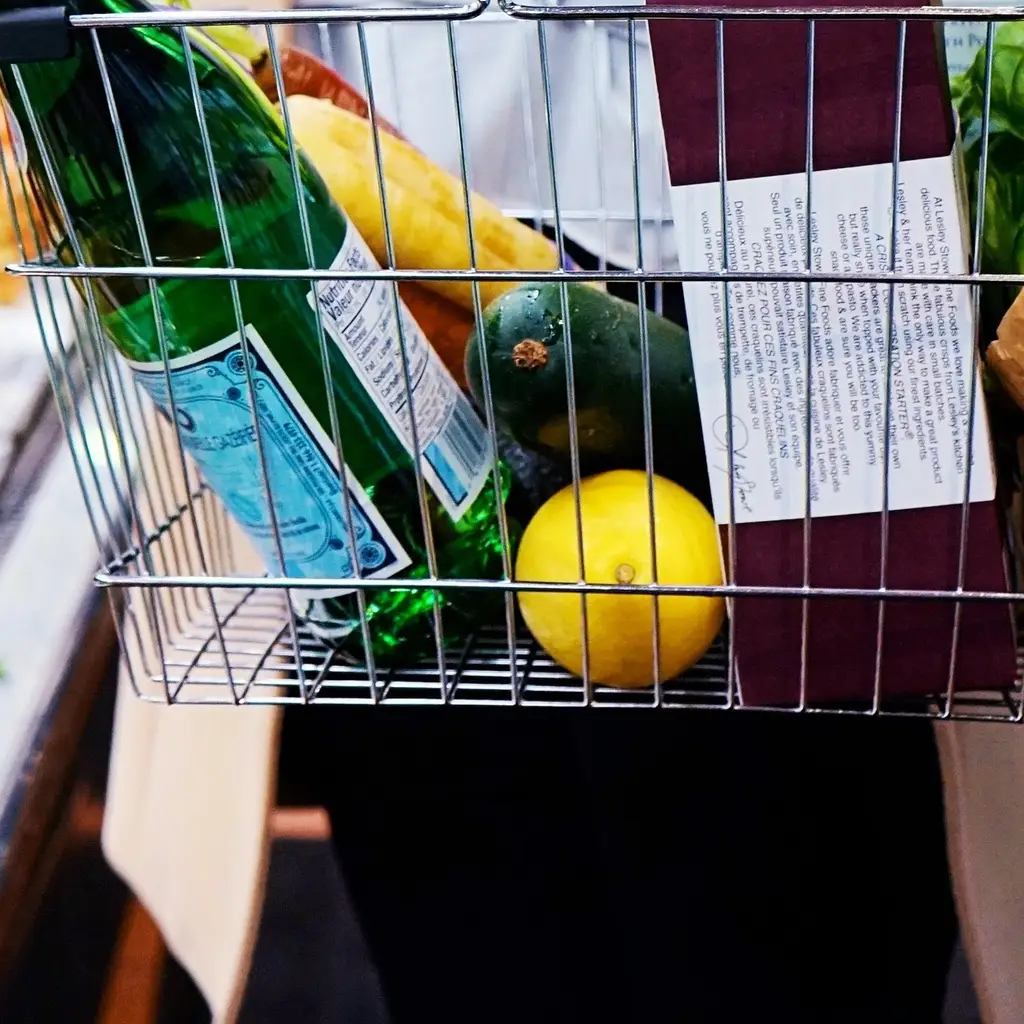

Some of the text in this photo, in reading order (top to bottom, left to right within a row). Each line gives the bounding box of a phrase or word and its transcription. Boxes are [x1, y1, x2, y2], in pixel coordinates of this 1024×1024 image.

[770, 191, 781, 214] Seul
[700, 211, 710, 234] vous
[783, 206, 793, 230] avec
[848, 213, 859, 229] but
[859, 206, 871, 233] these
[933, 210, 947, 243] Lesley
[837, 213, 850, 250] cheese
[849, 231, 863, 258] really
[901, 228, 912, 245] her
[774, 232, 789, 267] produit
[812, 246, 824, 272] Stow
[861, 236, 876, 270] unique
[904, 248, 916, 273] team
[915, 242, 924, 258] are
[327, 289, 355, 322] Valeur
[709, 292, 723, 313] plus
[747, 303, 756, 320] ces
[769, 281, 784, 318] pouvait
[858, 290, 870, 316] when
[898, 290, 911, 326] scratch
[911, 303, 922, 319] the
[922, 292, 933, 312] with
[714, 315, 724, 339] vous
[784, 307, 800, 348] fabriqué
[820, 305, 832, 335] Foods
[839, 317, 847, 333] are
[874, 318, 882, 334] are
[912, 321, 925, 342] only
[920, 187, 965, 474] delicious food. The fabulous crisps from Lesley's kitchen
[925, 315, 934, 336] care
[947, 305, 959, 336] Foods
[748, 323, 765, 373] craquelins
[776, 319, 790, 364] satisfaire
[811, 326, 825, 368] fabuleux
[841, 336, 851, 357] sure
[853, 334, 861, 350] are
[860, 319, 875, 353] topped
[901, 328, 915, 355] using
[792, 351, 801, 374] avec
[824, 338, 836, 366] adore
[915, 345, 926, 364] way
[930, 351, 942, 378] small
[758, 298, 788, 459] POUR CES FINS CRAQUELINS
[843, 360, 854, 378] you
[855, 353, 869, 395] addicted
[867, 356, 878, 376] with
[907, 358, 915, 374] our
[953, 356, 965, 376] love
[744, 373, 760, 414] fromage
[757, 376, 769, 397] sont
[780, 367, 795, 398] Lesley
[795, 376, 806, 395] des
[815, 370, 832, 420] craquelins
[826, 369, 842, 412] fabriquer
[847, 381, 858, 396] will
[868, 378, 879, 399] your
[910, 377, 922, 403] finest
[921, 379, 933, 406] make
[955, 379, 970, 415] making
[761, 399, 776, 454] irrésistibles
[788, 413, 797, 432] son
[809, 399, 822, 434] cuisine
[863, 410, 874, 428] this
[824, 423, 836, 444] sont
[836, 427, 845, 451] vous
[925, 418, 938, 444] great
[864, 430, 877, 466] yummy
[891, 448, 900, 469] own
[814, 452, 829, 483] Lesley
[826, 447, 842, 493] fabriqués
[839, 453, 851, 476] offrir
[928, 446, 944, 484] product
